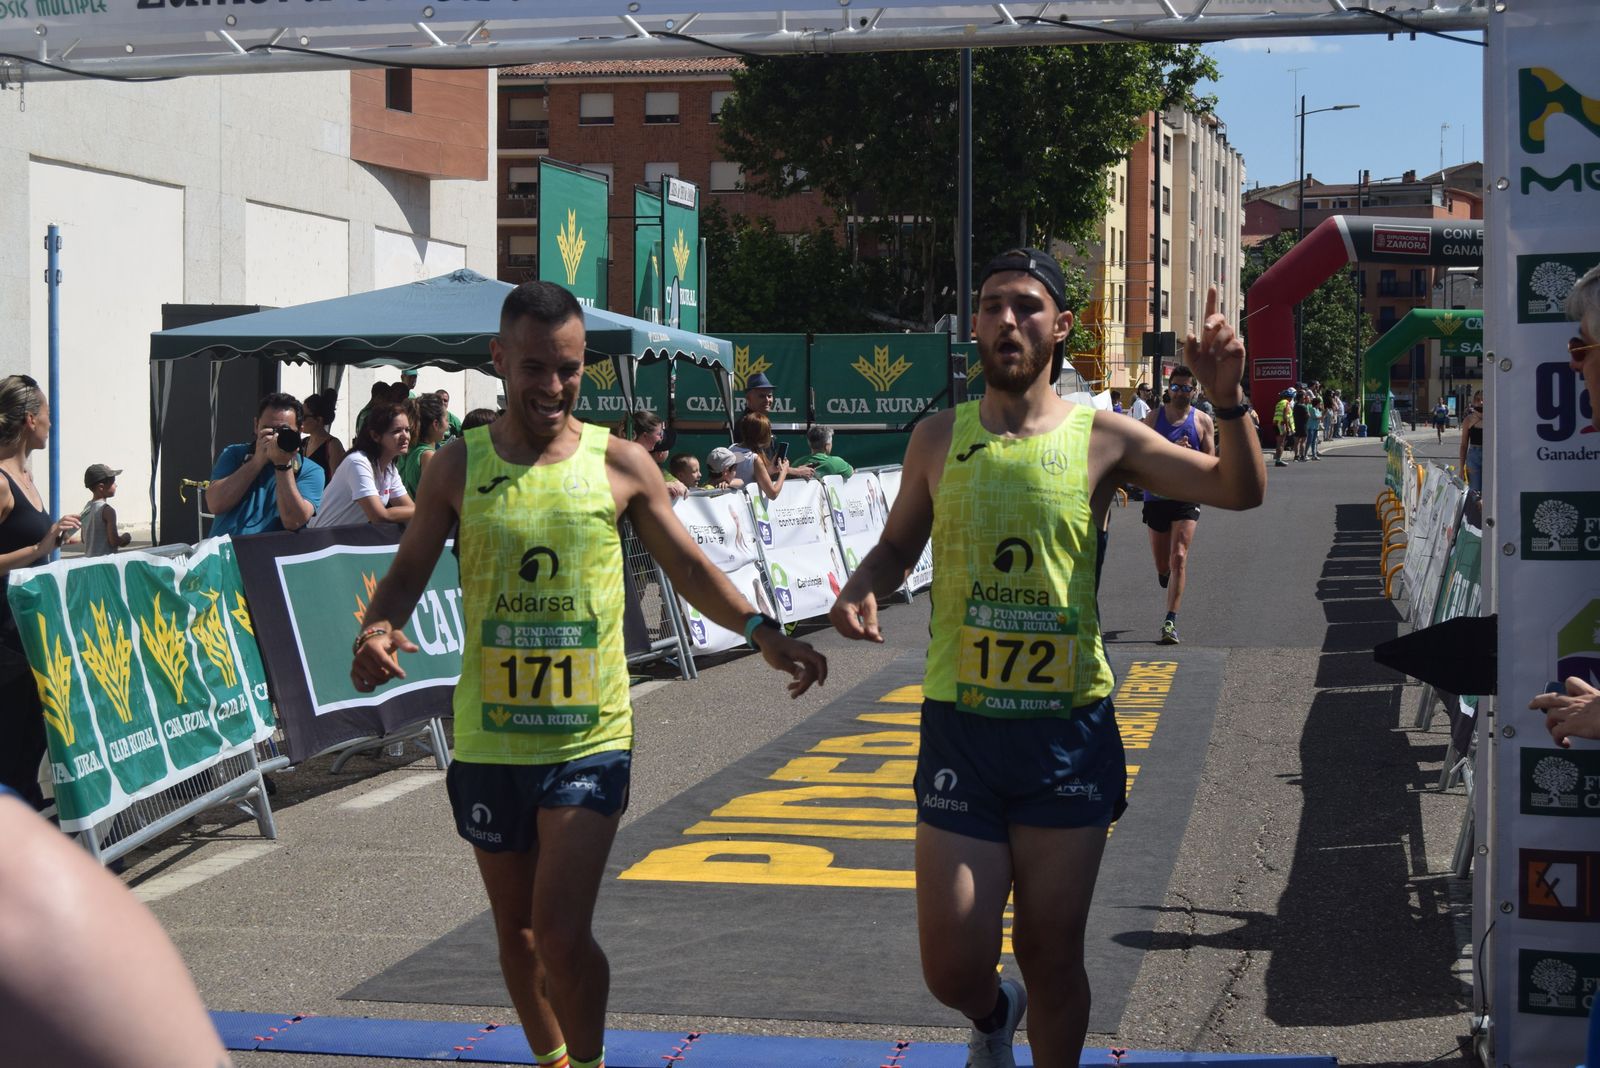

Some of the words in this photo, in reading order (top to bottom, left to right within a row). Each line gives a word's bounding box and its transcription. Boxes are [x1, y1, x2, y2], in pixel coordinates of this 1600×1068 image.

[1443, 228, 1472, 240] CON
[1386, 240, 1427, 250] ZAMORA
[827, 398, 871, 415] CAJA
[876, 397, 939, 414] RURAL
[972, 581, 1050, 606] Adarsa
[495, 593, 575, 613] Adarsa
[514, 626, 582, 638] FUNDACION
[993, 620, 1019, 631] CAJA
[1023, 621, 1061, 632] RURAL
[514, 637, 542, 647] CAJA
[545, 636, 582, 647] RURAL
[973, 635, 1056, 684] 172
[500, 655, 572, 699] 171
[985, 696, 1016, 710] CAJA
[512, 713, 544, 725] CAJA
[548, 713, 592, 726] RURAL
[127, 727, 159, 756] RURAL
[922, 793, 969, 812] Adarsa
